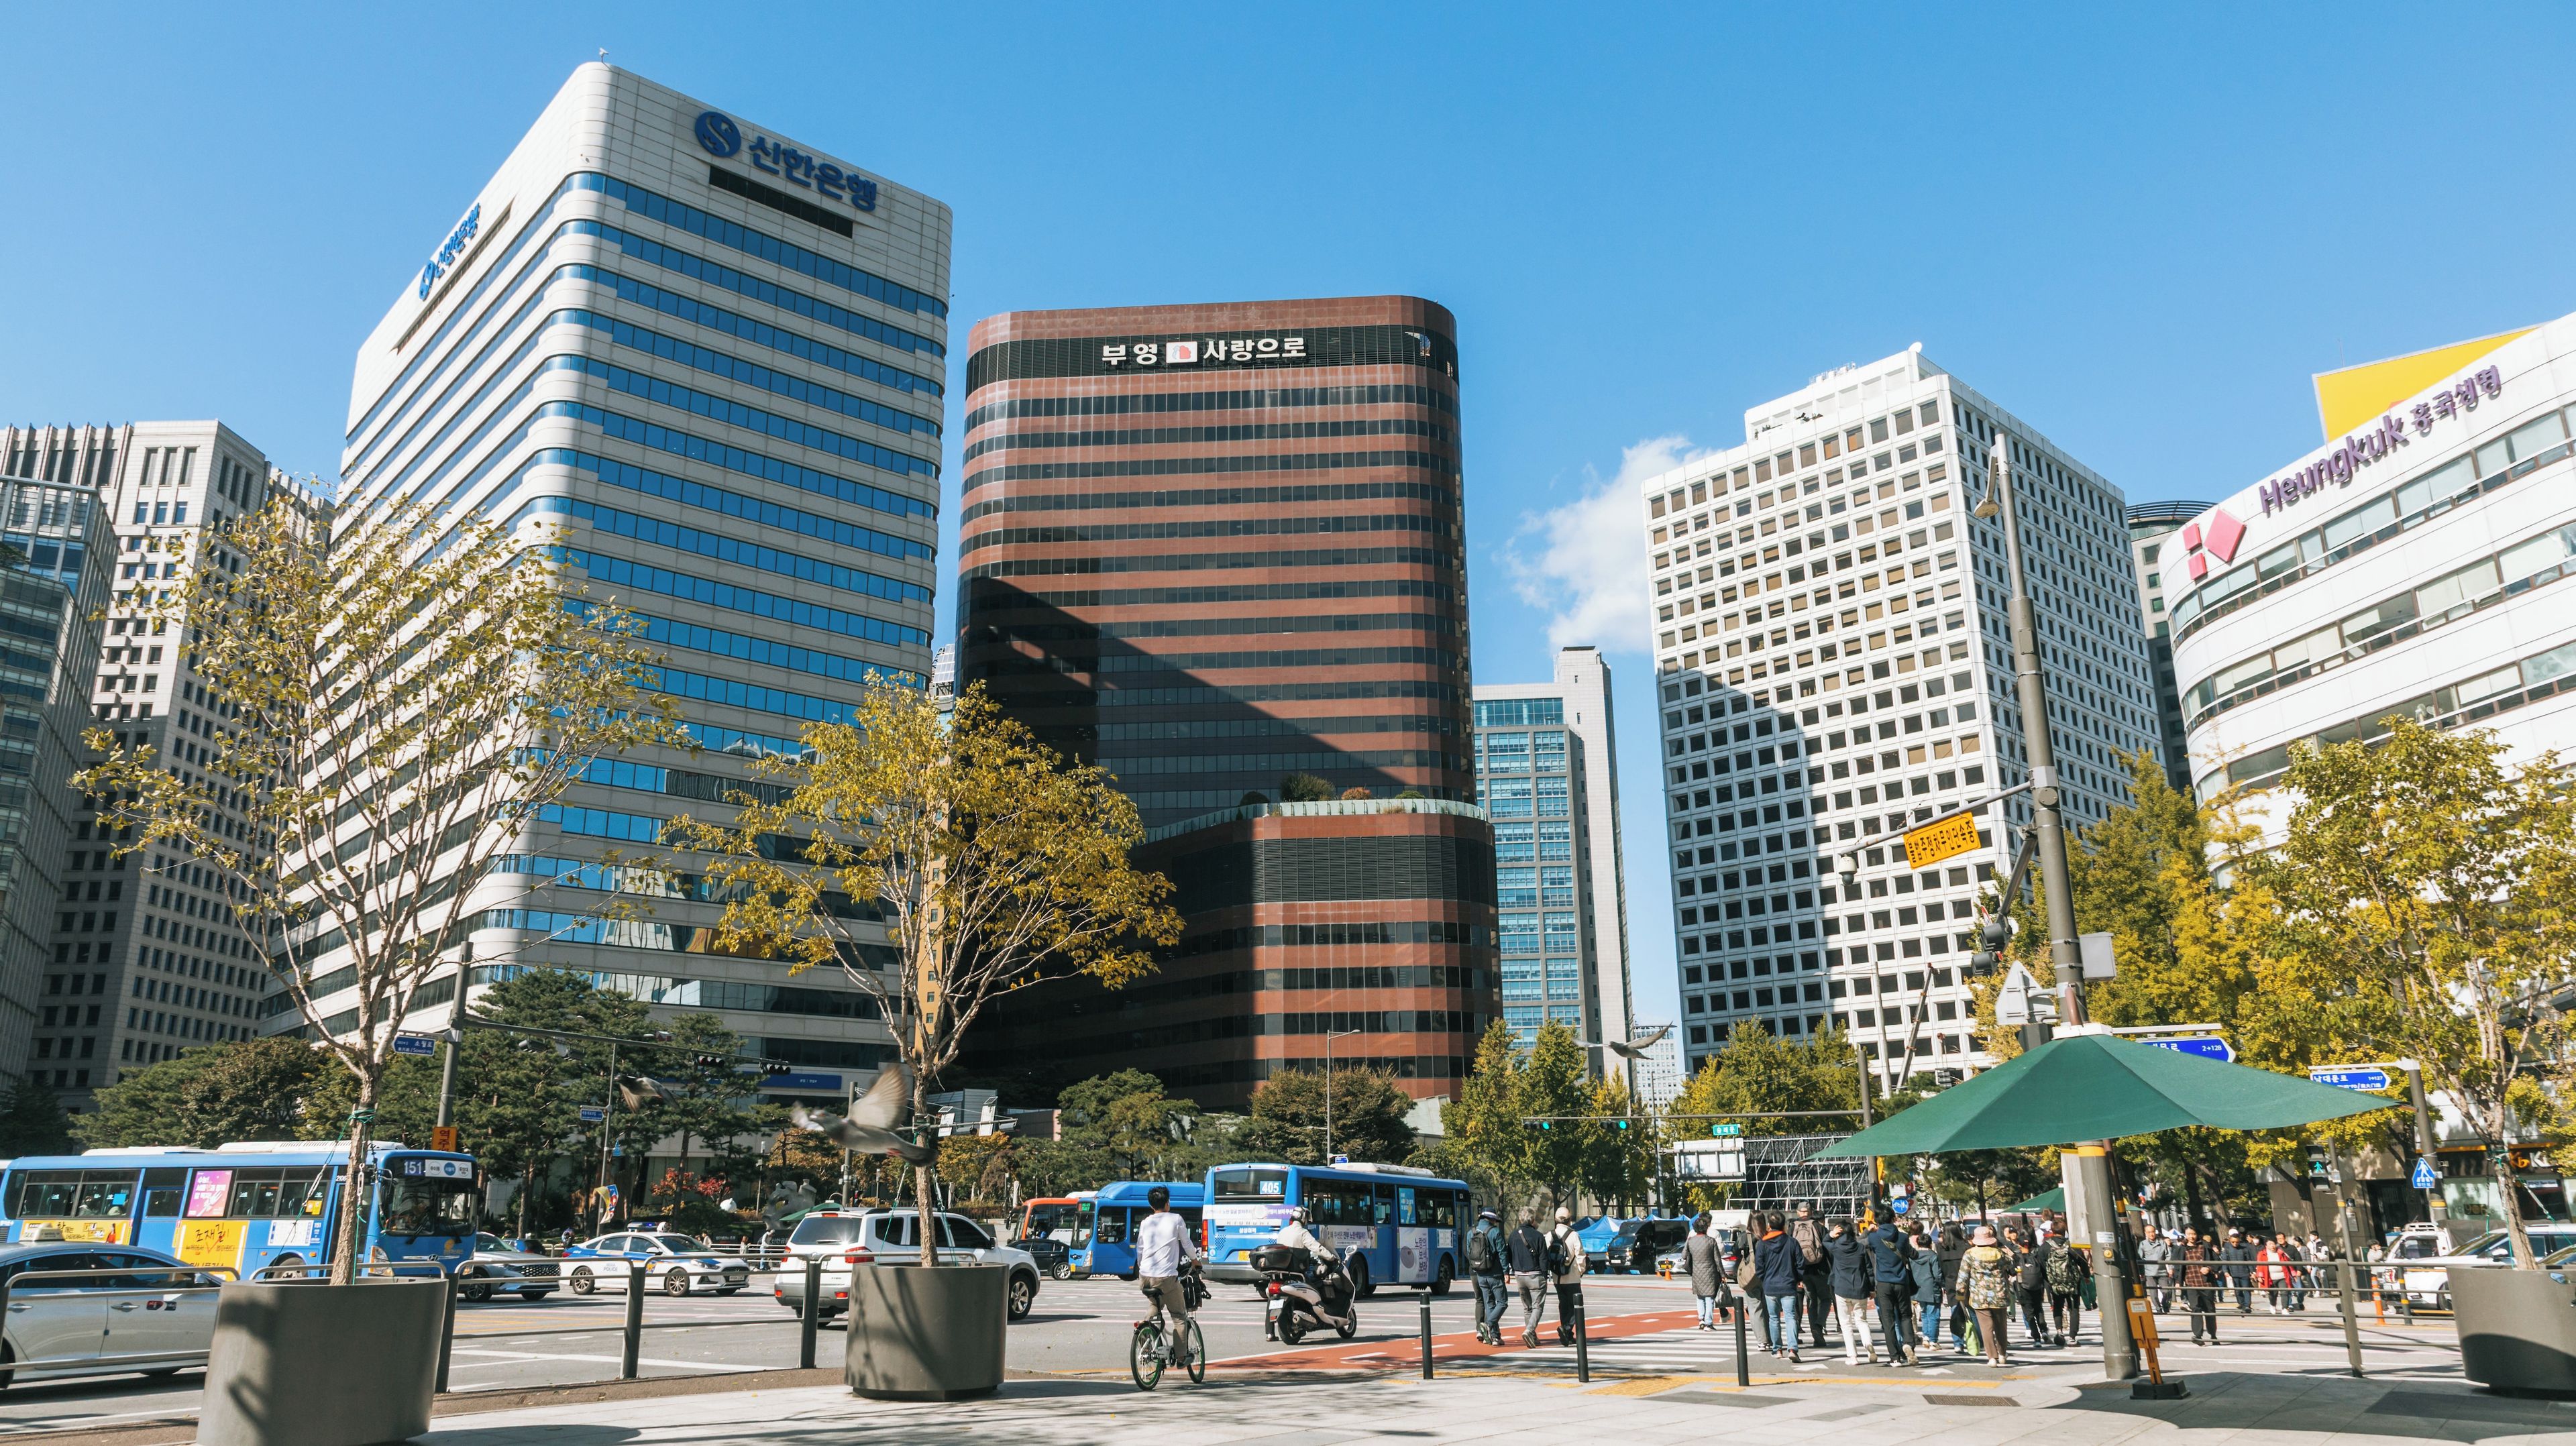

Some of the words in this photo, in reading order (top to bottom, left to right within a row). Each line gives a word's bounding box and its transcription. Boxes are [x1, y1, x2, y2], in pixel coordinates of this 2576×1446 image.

[749, 135, 877, 212] 신한은행
[435, 203, 481, 279] 신한은행
[1102, 343, 1159, 366] 부영
[1203, 337, 1306, 362] 사랑으로
[2259, 414, 2408, 515] Heungkuk
[2410, 365, 2502, 432] 흥국생명
[1908, 820, 1976, 864] 불법주정차무인단속중
[1717, 1125, 1735, 1133] 숭례문
[404, 1162, 422, 1175] 151
[1262, 1182, 1279, 1193] 405
